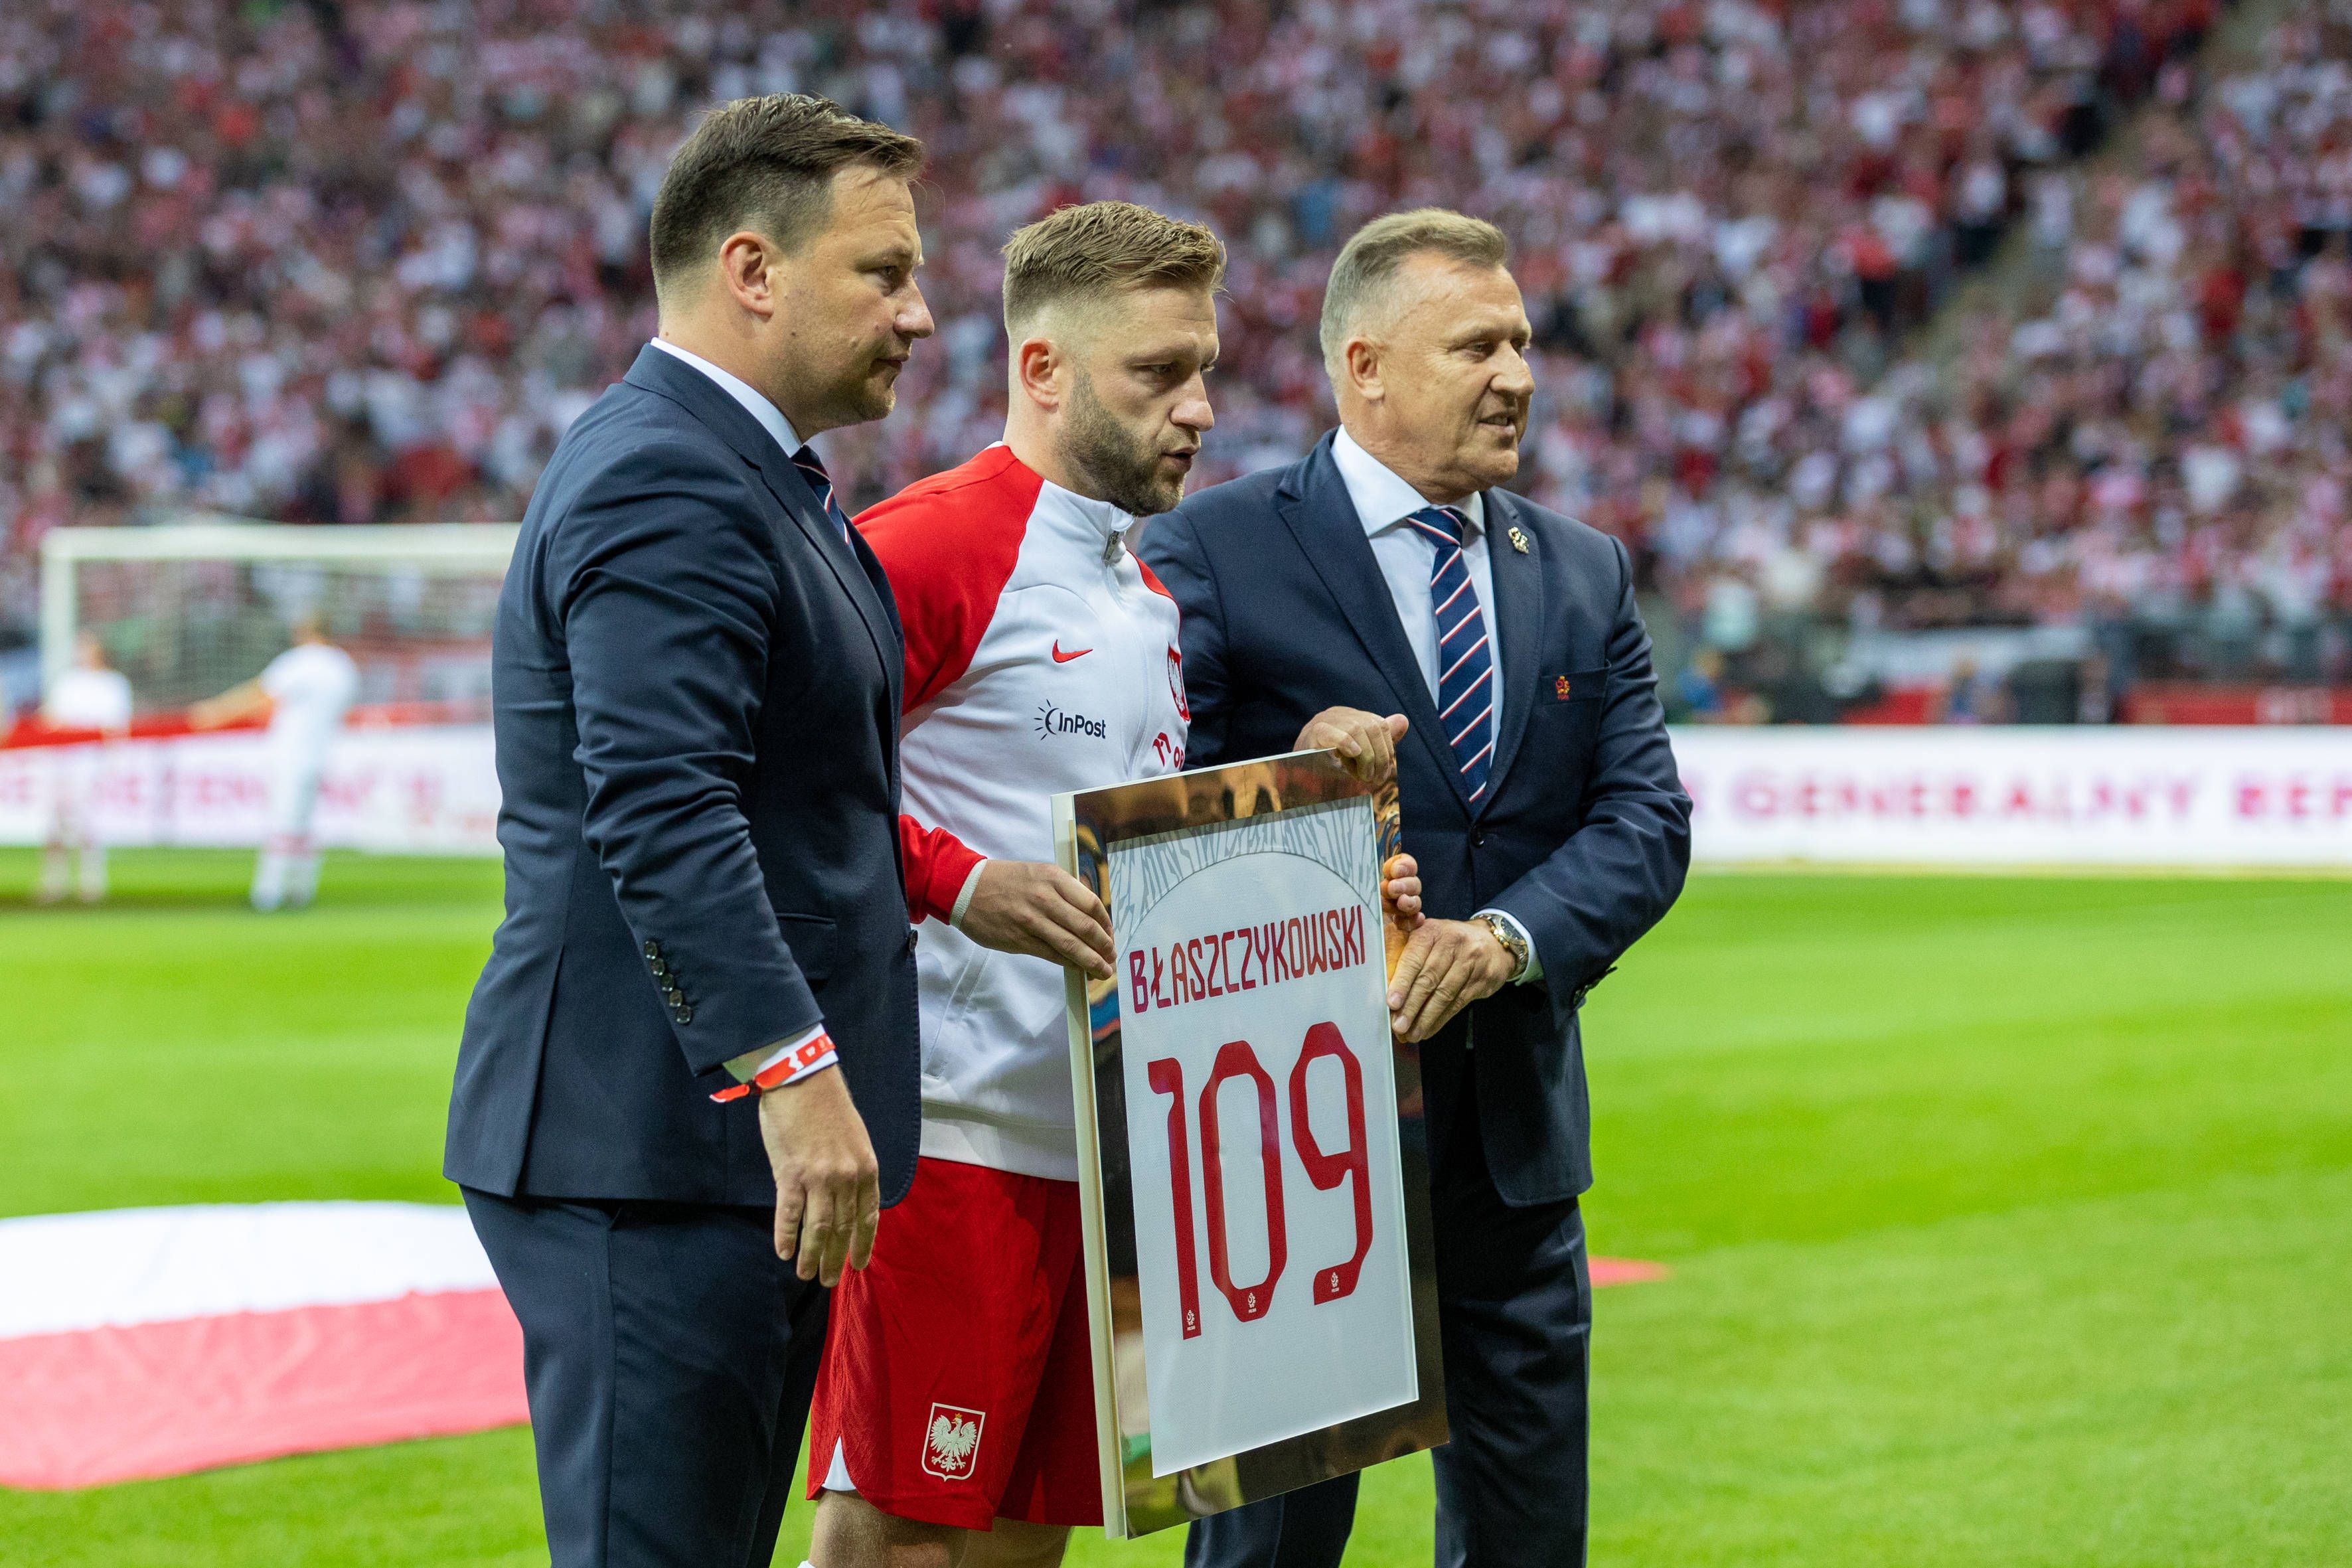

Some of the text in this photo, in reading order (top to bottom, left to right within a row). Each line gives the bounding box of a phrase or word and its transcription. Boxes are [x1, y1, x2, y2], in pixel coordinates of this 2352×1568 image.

[1058, 712, 1106, 739] InPost
[1728, 771, 2204, 822] GENERALNY
[1129, 904, 1366, 1014] BŁASZCZYKOWSKI
[1146, 1021, 1373, 1340] 109
